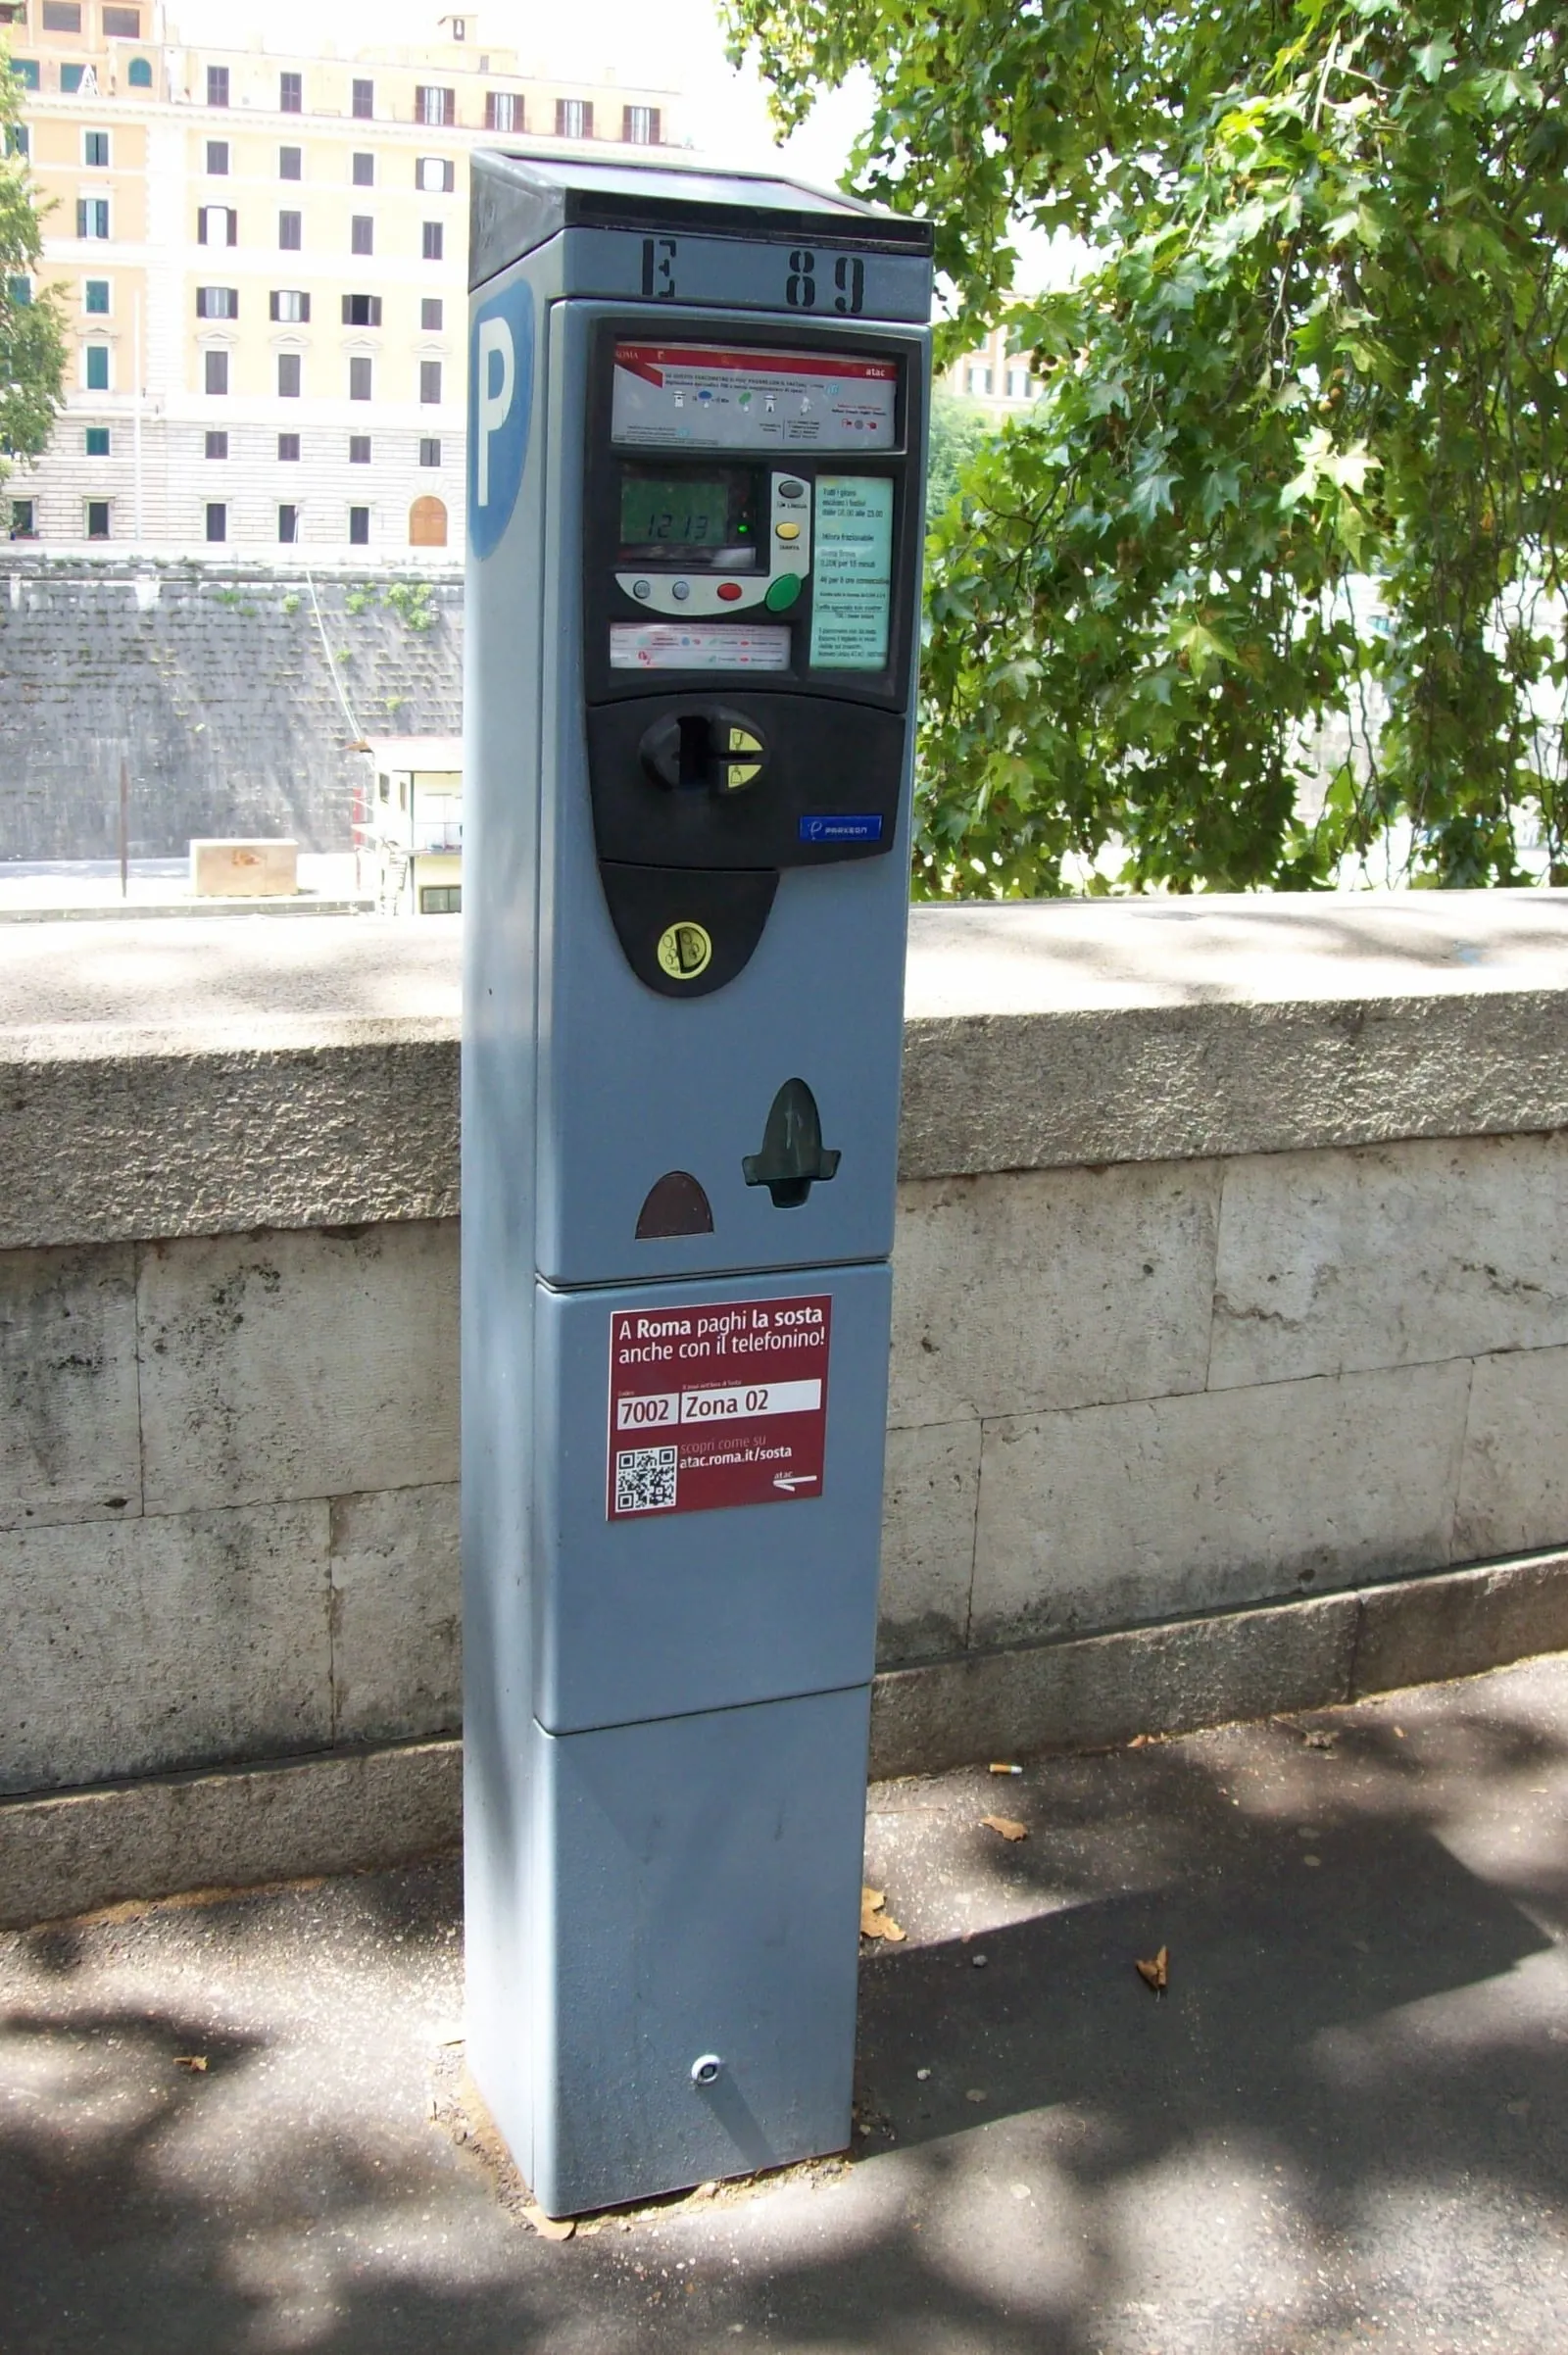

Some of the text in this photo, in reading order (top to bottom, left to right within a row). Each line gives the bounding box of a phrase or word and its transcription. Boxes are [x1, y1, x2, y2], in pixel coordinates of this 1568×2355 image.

[642, 238, 864, 314] E 89
[865, 367, 886, 376] atac
[478, 316, 515, 507] P
[618, 1306, 823, 1341] A Roma paghi la sosta
[618, 1326, 825, 1364] anche con il telefonino!
[621, 1399, 669, 1424] 7002
[685, 1389, 769, 1418] Zona 02
[679, 1446, 792, 1469] atac.roma.it/sosta
[680, 1435, 766, 1455] scopri come su
[774, 1470, 793, 1480] atac
